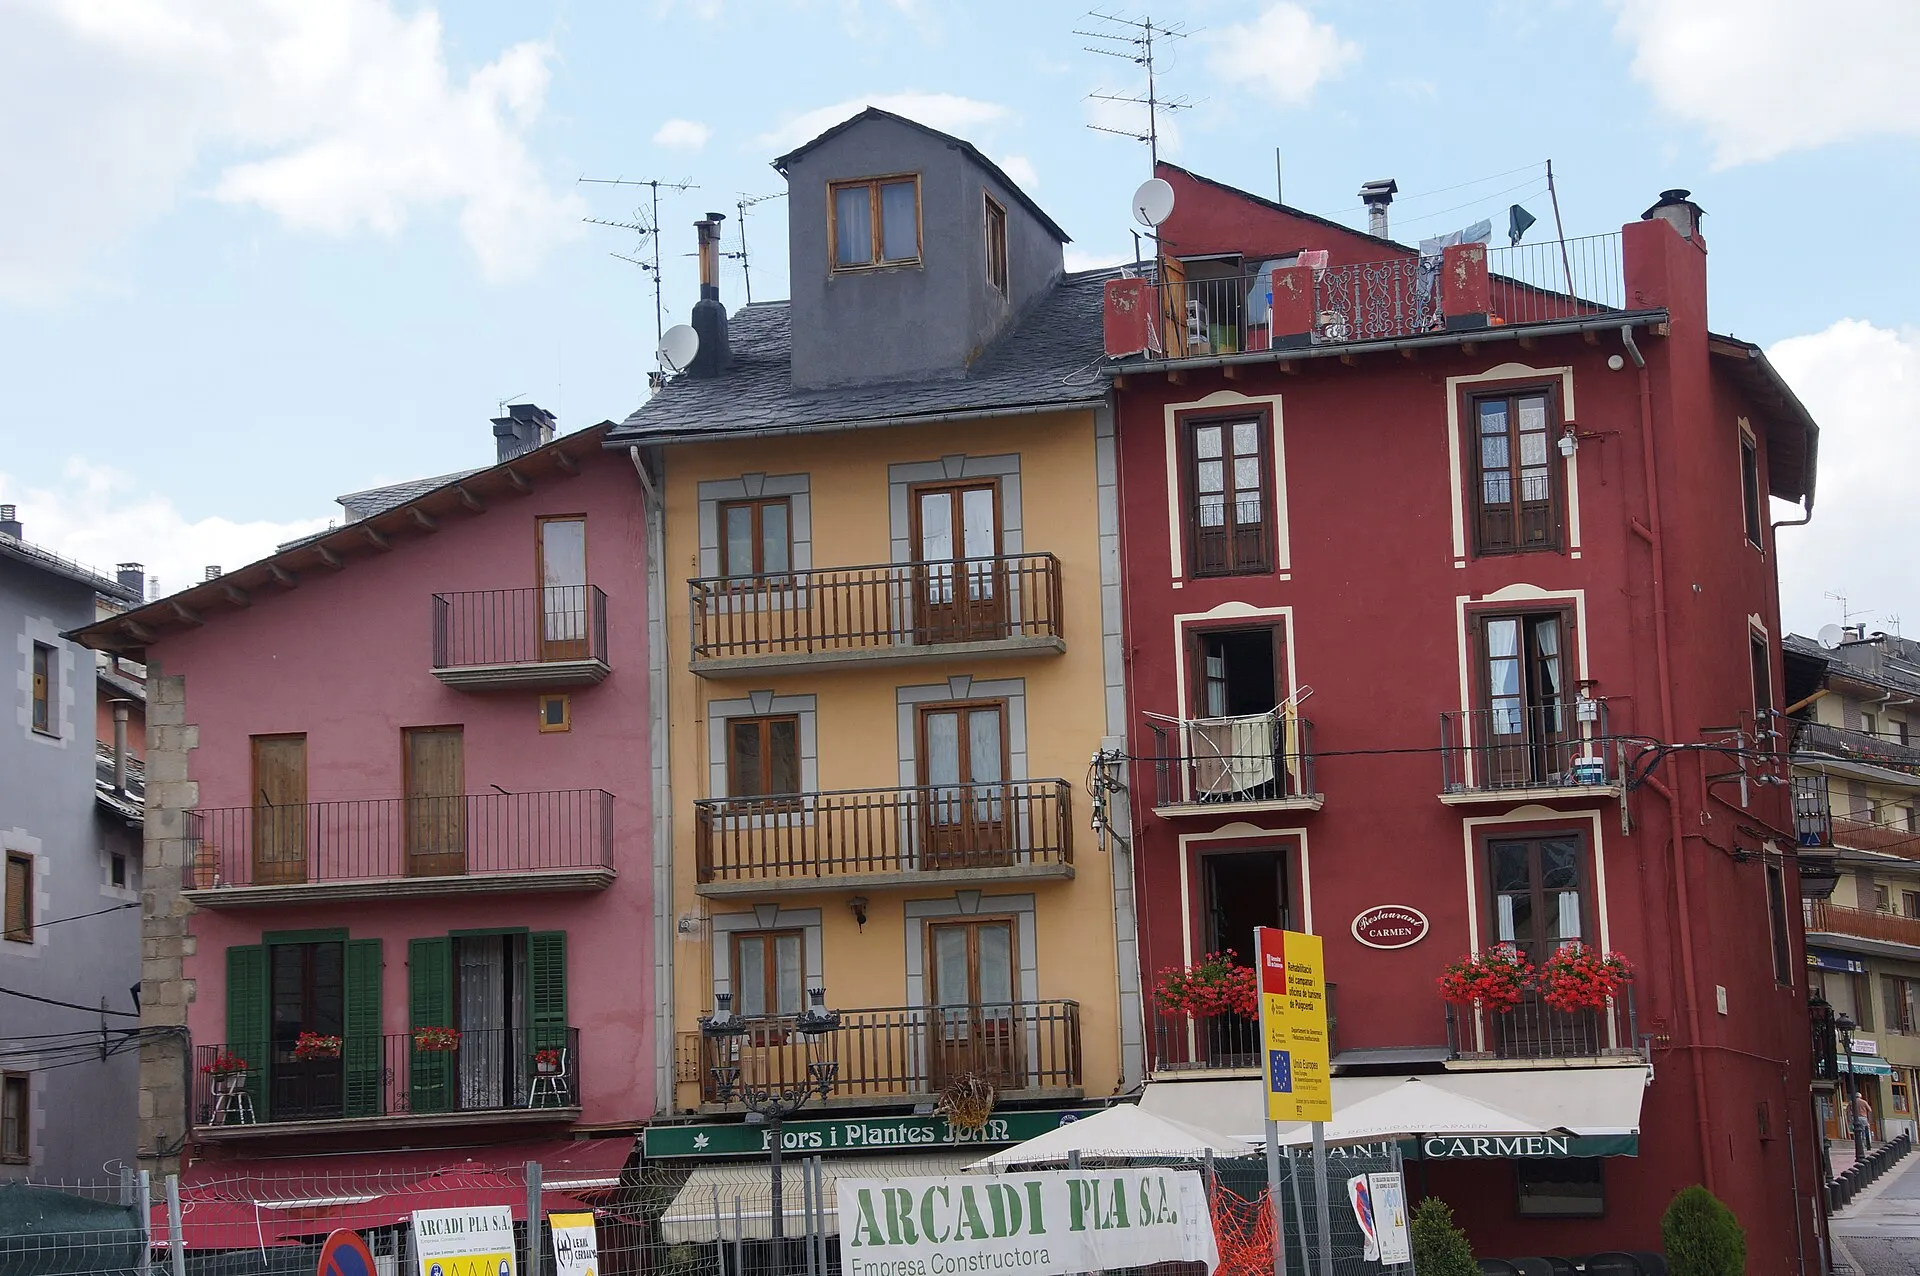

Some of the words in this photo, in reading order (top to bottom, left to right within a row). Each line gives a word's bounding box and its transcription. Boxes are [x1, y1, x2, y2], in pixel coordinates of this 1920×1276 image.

[1358, 910, 1423, 931] Restaurant
[1369, 928, 1412, 938] CARMEN
[1289, 999, 1295, 1008] de
[1303, 1059, 1318, 1071] Europea
[830, 1126, 838, 1146] i
[844, 1122, 935, 1146] Plantes
[1424, 1136, 1570, 1157] CARMEN
[851, 1181, 1047, 1247] ARCADI
[1066, 1178, 1131, 1231] PLA
[1139, 1176, 1177, 1227] S.A.
[420, 1217, 463, 1236] ARCADI
[468, 1216, 488, 1232] PLA
[492, 1215, 511, 1231] S.A.
[852, 1258, 927, 1276] Empresa
[931, 1247, 1051, 1274] Constructora
